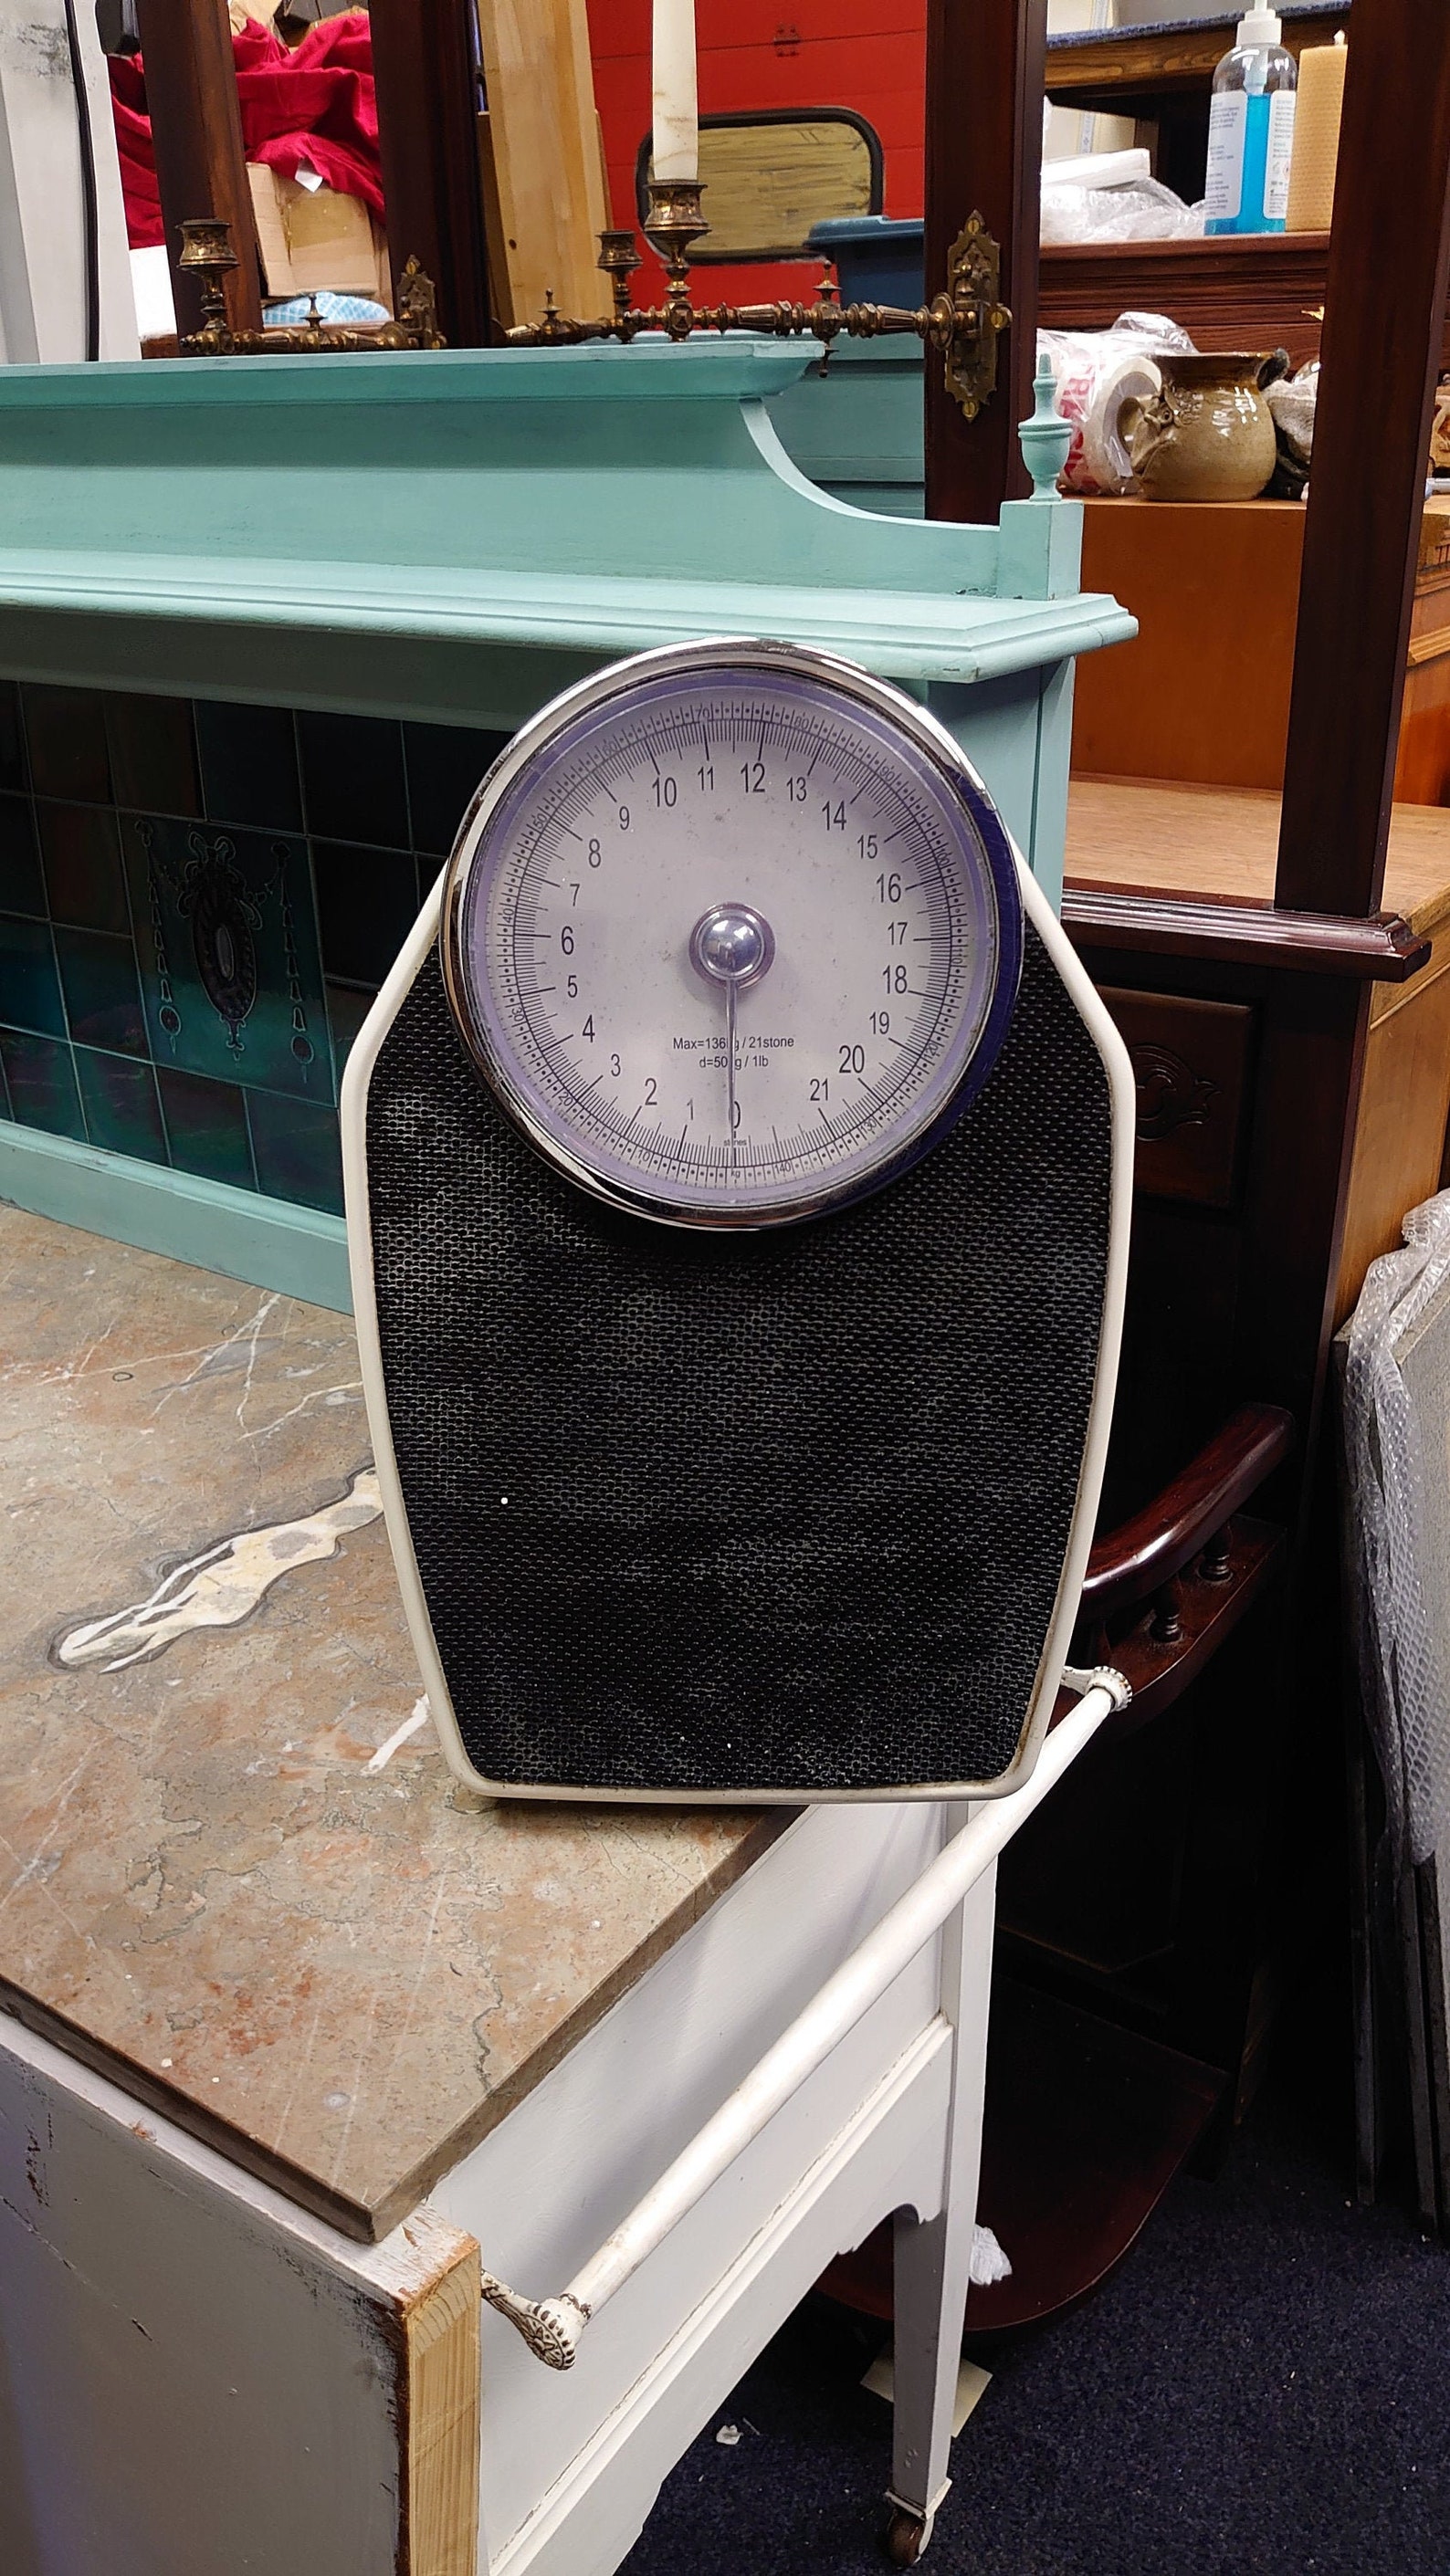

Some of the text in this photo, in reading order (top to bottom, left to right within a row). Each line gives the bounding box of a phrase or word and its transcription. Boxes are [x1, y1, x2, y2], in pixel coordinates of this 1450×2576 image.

[698, 766, 714, 791] 11
[741, 763, 765, 793] 12
[880, 766, 895, 781] 90
[652, 777, 677, 807] 10
[786, 777, 807, 801] 13
[532, 812, 548, 829] 50
[619, 806, 630, 830] 9
[822, 801, 846, 831] 14
[589, 838, 601, 868] 8
[856, 834, 877, 859] 15
[570, 883, 580, 906] 7
[877, 873, 901, 903] 16
[502, 908, 514, 923] 40
[562, 926, 574, 955] 6
[888, 922, 908, 946] 17
[567, 975, 578, 998] 5
[883, 965, 908, 994] 18
[511, 1007, 525, 1021] 30
[869, 1011, 889, 1034] 19
[582, 1014, 595, 1042] 4
[749, 1036, 794, 1049] 21stone
[924, 1042, 939, 1060] 120
[611, 1053, 621, 1077] 3
[752, 1055, 769, 1067] 1lb
[838, 1044, 865, 1073] 20
[558, 1092, 573, 1106] 20
[645, 1077, 657, 1105] 2
[809, 1078, 829, 1101] 21
[686, 1098, 694, 1120] 1
[860, 1118, 877, 1131] 130
[775, 1162, 791, 1174] 140
